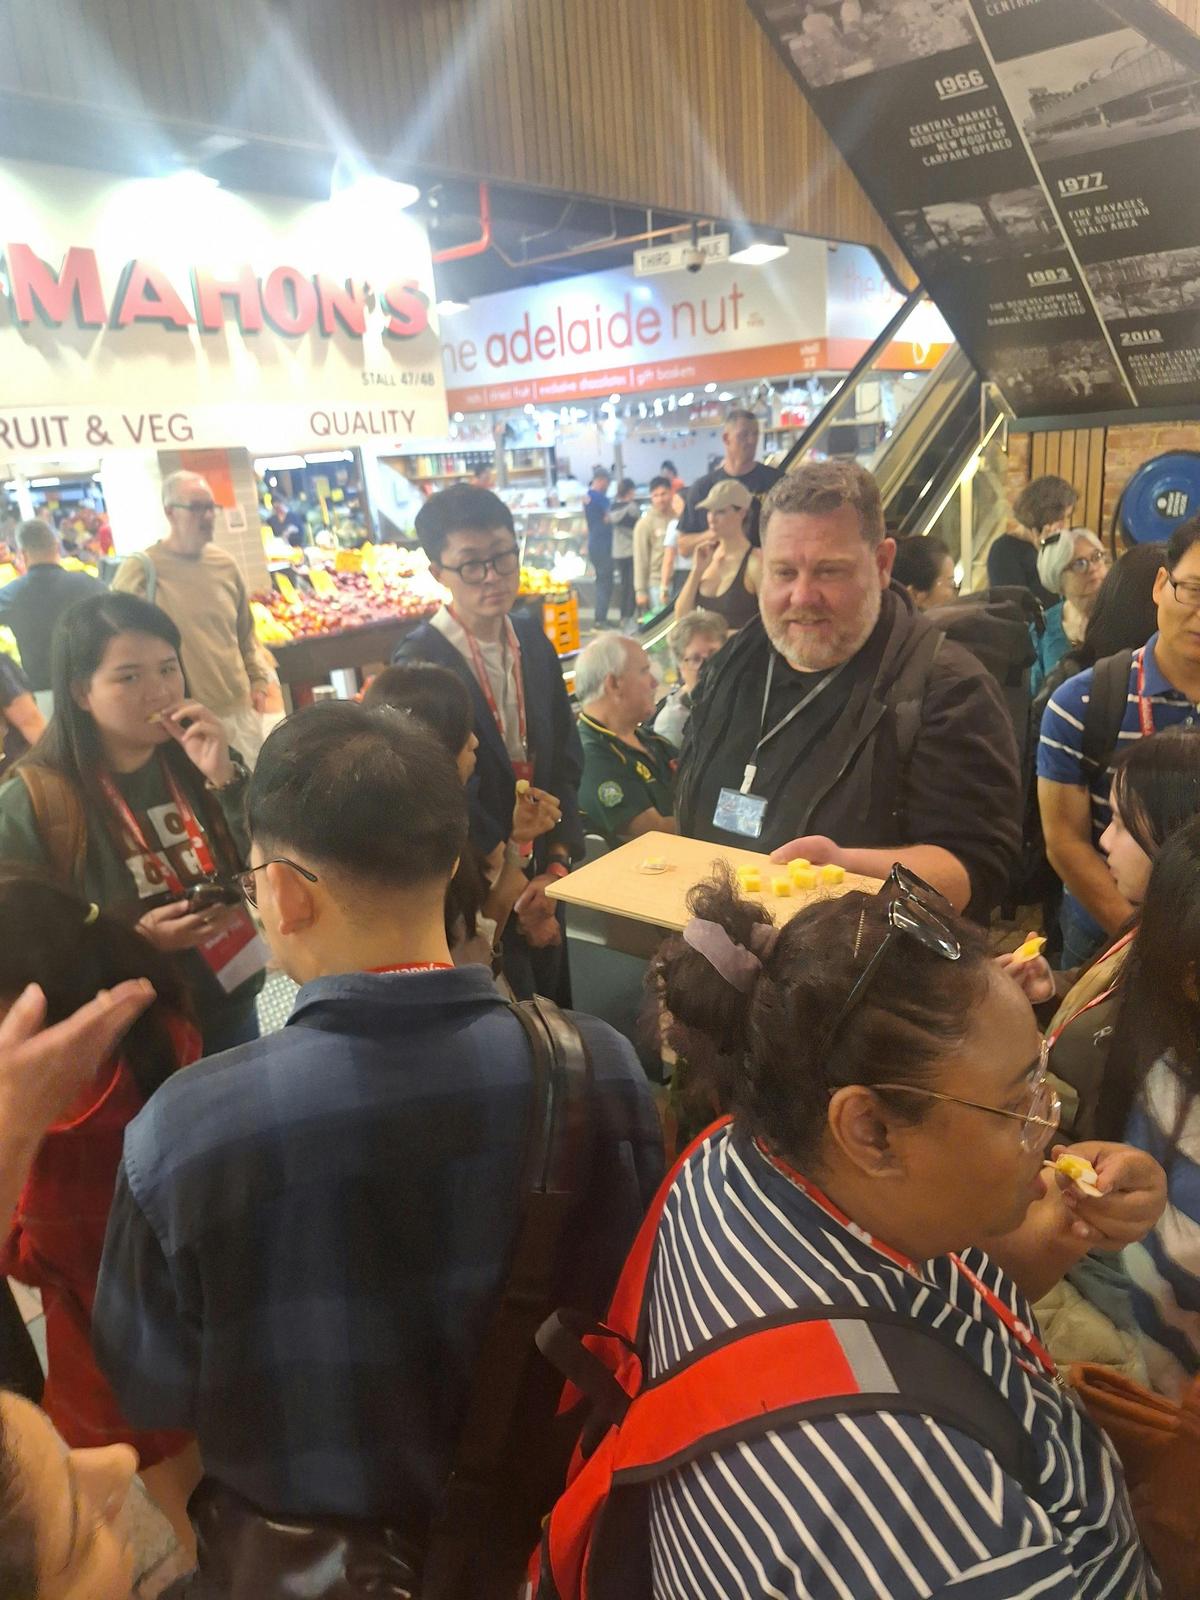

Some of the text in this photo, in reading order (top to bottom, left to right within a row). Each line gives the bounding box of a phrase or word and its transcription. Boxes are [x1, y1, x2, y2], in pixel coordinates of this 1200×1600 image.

[934, 70, 985, 97] 1966
[909, 105, 999, 137] CENTRAL MARKET
[909, 120, 992, 148] REDEVELOPMENT
[922, 138, 1013, 167] CARPARK OPENED
[936, 127, 1007, 153] NEW ROOFTOP
[1058, 171, 1103, 194] 1977
[1068, 198, 1145, 219] FIRE RAVAGES
[1094, 207, 1150, 225] SOUTHERN
[1076, 219, 1139, 237] STALL AREA
[485, 292, 662, 368] adelaide
[671, 282, 744, 339] nut
[1120, 329, 1162, 346] 2019
[361, 372, 397, 386] STALL
[85, 414, 114, 447] &
[122, 413, 194, 445] VEG
[309, 410, 416, 437] QUALITY
